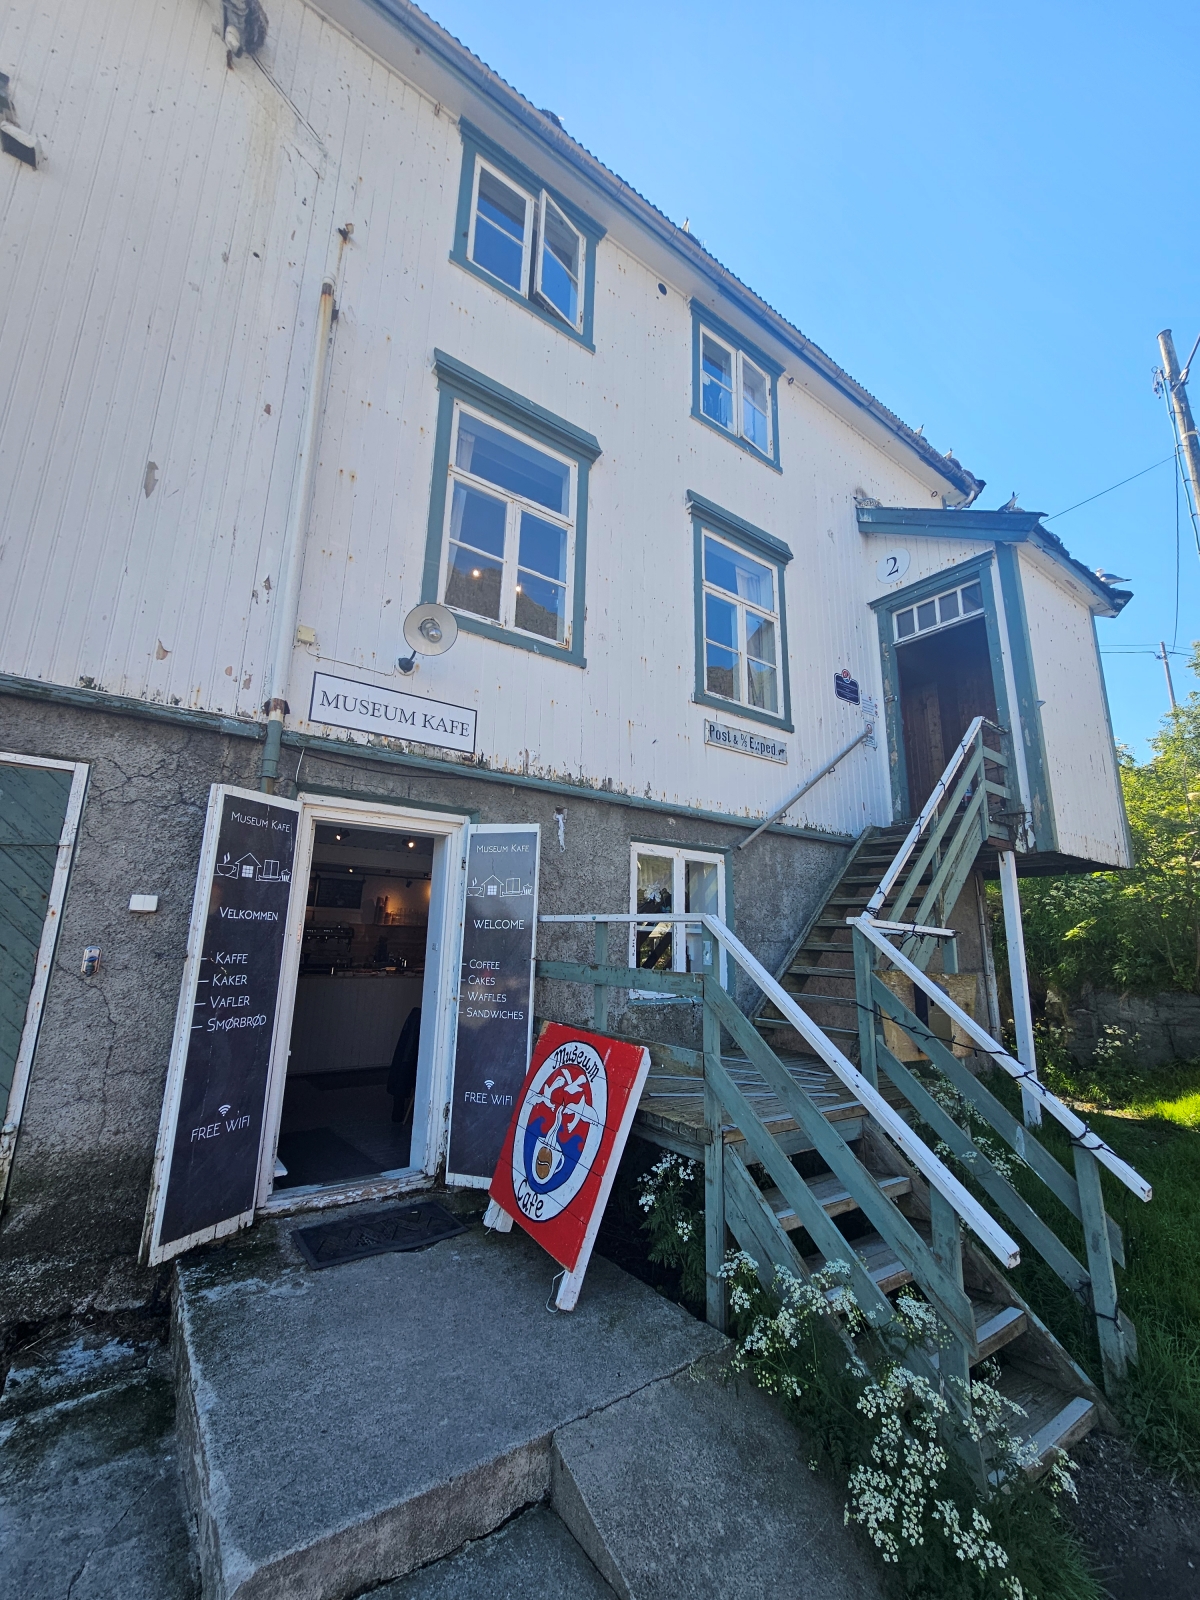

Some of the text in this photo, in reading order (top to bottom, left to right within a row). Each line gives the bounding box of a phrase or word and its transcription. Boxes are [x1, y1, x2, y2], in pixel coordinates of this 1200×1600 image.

[886, 556, 899, 577] 2
[319, 690, 470, 738] MUSEUM KAFE
[709, 724, 732, 744] Post
[733, 735, 739, 745] &
[231, 811, 291, 833] MUSEUM KAFE
[476, 844, 530, 853] MUSEUM KAFE
[219, 906, 279, 921] VELKOMMEN
[473, 919, 525, 930] WELCOME
[215, 951, 249, 964] KAFFE
[469, 958, 500, 970] COFFEE
[212, 973, 248, 987] KAKER
[467, 974, 496, 986] CAKES
[210, 995, 250, 1009] VAFLER
[467, 991, 507, 1003] WAFFLES
[466, 1007, 524, 1020] SANDWICHES
[206, 1013, 267, 1032] SMØRBRØD
[552, 1045, 600, 1083] Museum
[464, 1091, 513, 1106] FREE WIFI
[190, 1115, 250, 1142] FREE WIFI
[516, 1178, 545, 1219] Cafe
